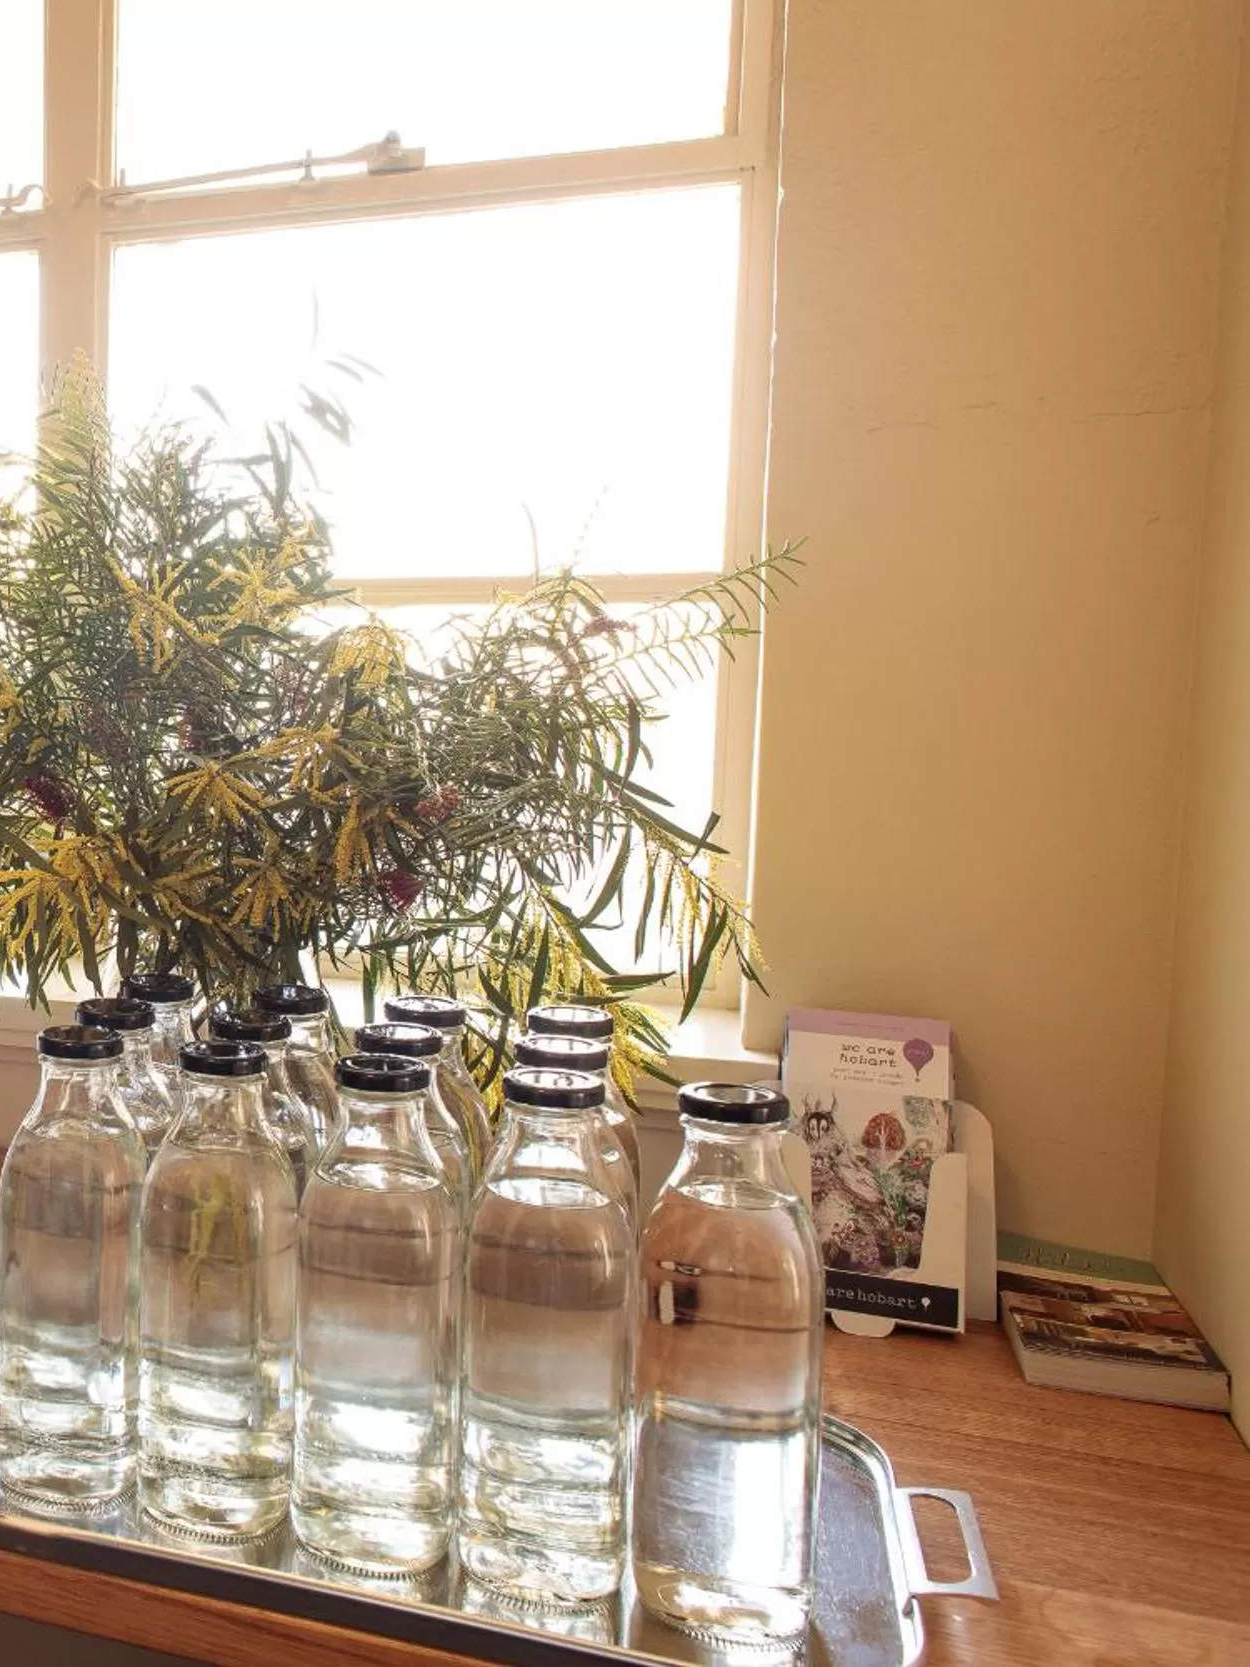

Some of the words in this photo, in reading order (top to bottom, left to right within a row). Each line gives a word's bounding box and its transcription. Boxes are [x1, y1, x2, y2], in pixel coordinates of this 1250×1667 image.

[841, 1043, 861, 1053] we
[866, 1045, 896, 1056] are
[839, 1053, 897, 1068] hobart
